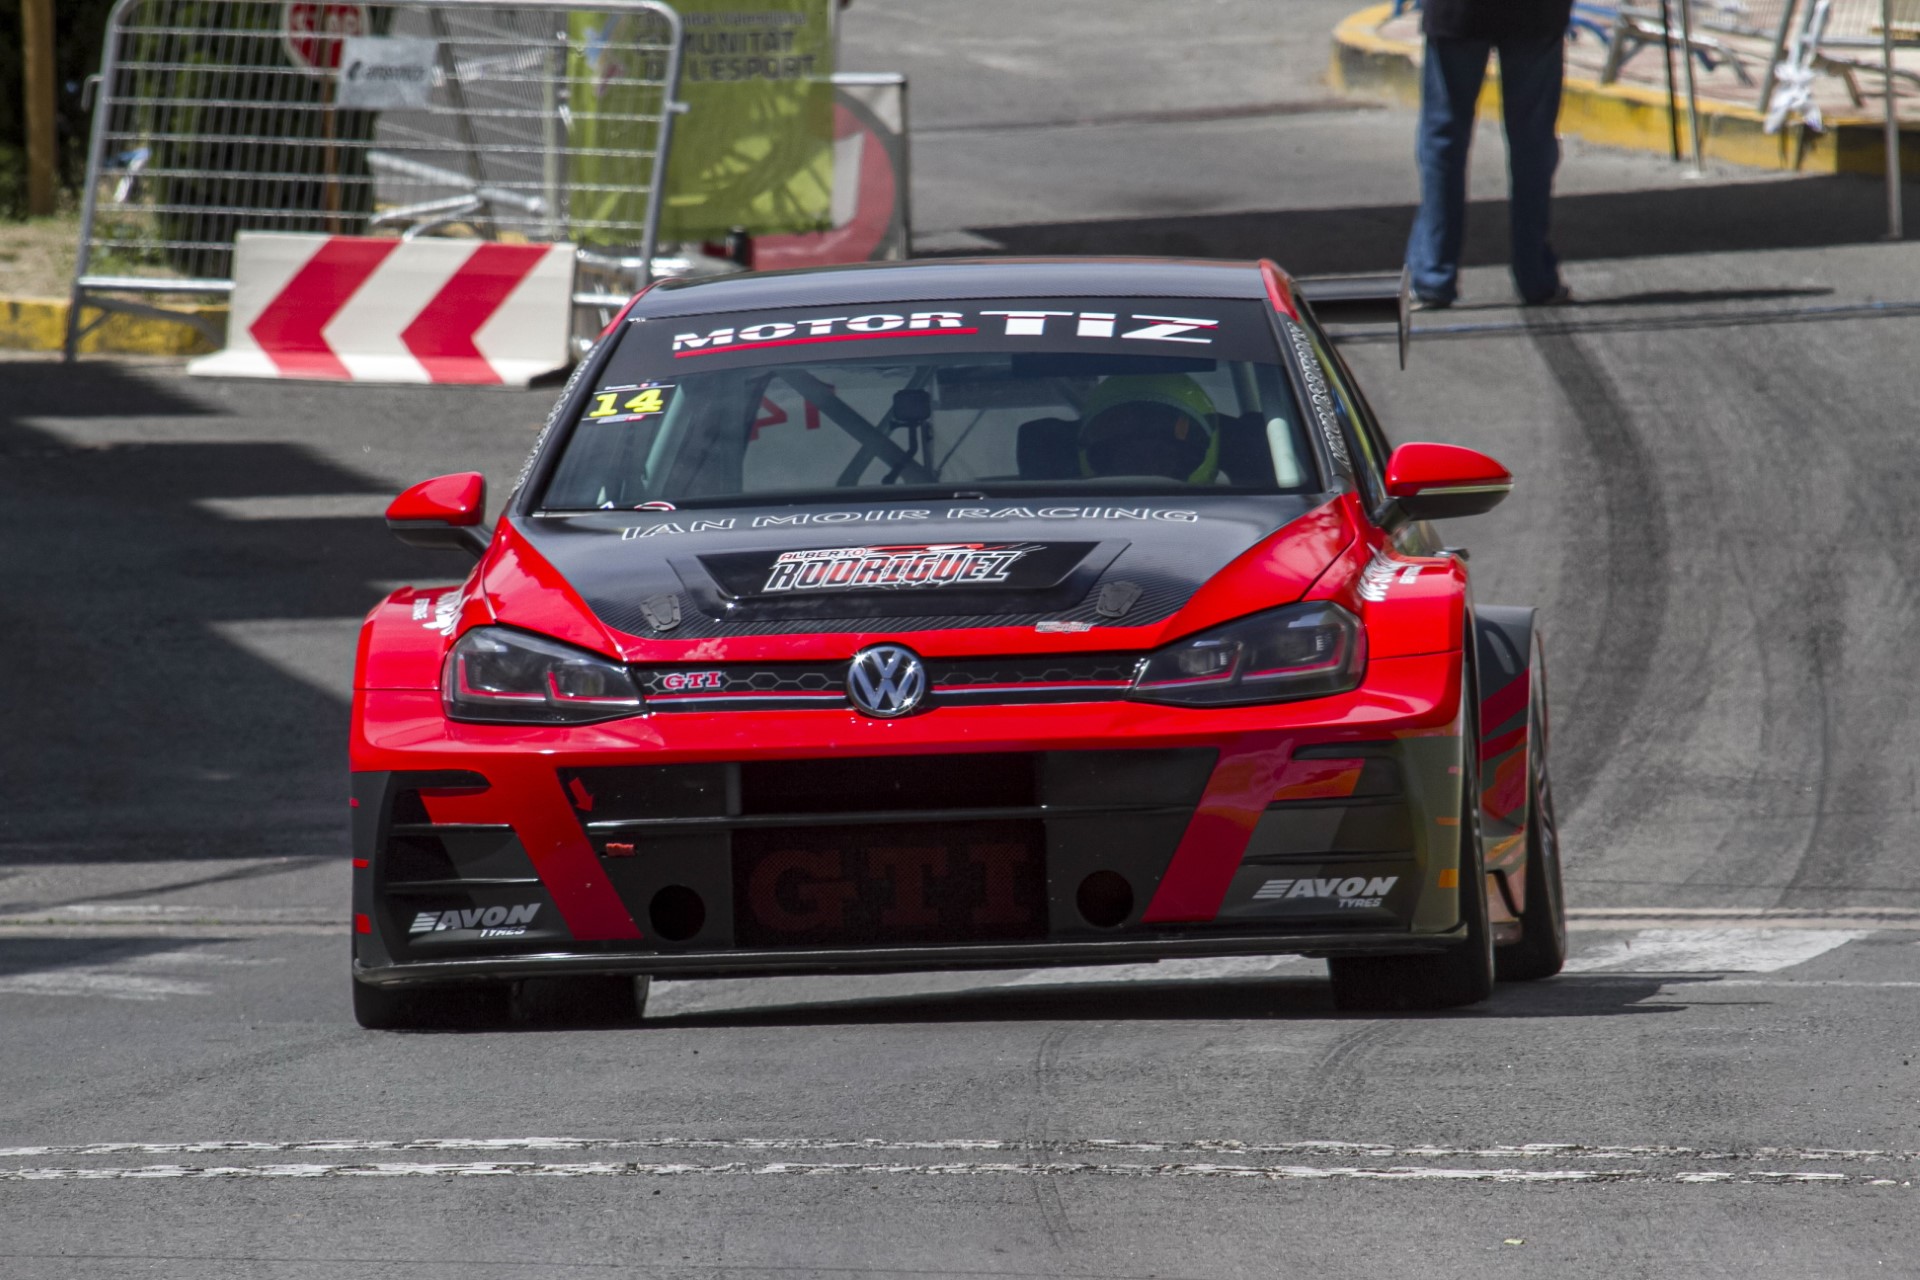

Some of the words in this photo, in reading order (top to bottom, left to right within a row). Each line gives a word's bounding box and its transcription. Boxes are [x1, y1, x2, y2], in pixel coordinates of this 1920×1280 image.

[672, 312, 964, 350] MOTOR
[979, 311, 1219, 343] TIZ
[589, 388, 664, 417] 14
[621, 518, 737, 541] IAN
[752, 509, 931, 528] MOIR
[947, 507, 1199, 523] RACING
[779, 548, 866, 563] ALBERTO
[761, 550, 1023, 592] RODRIGUEZ
[663, 672, 722, 690] GTI
[748, 843, 1031, 932] GTI
[1283, 876, 1400, 899] AVON
[434, 902, 542, 931] AVON
[1338, 897, 1383, 909] TYRES
[479, 924, 528, 938] TYRES
